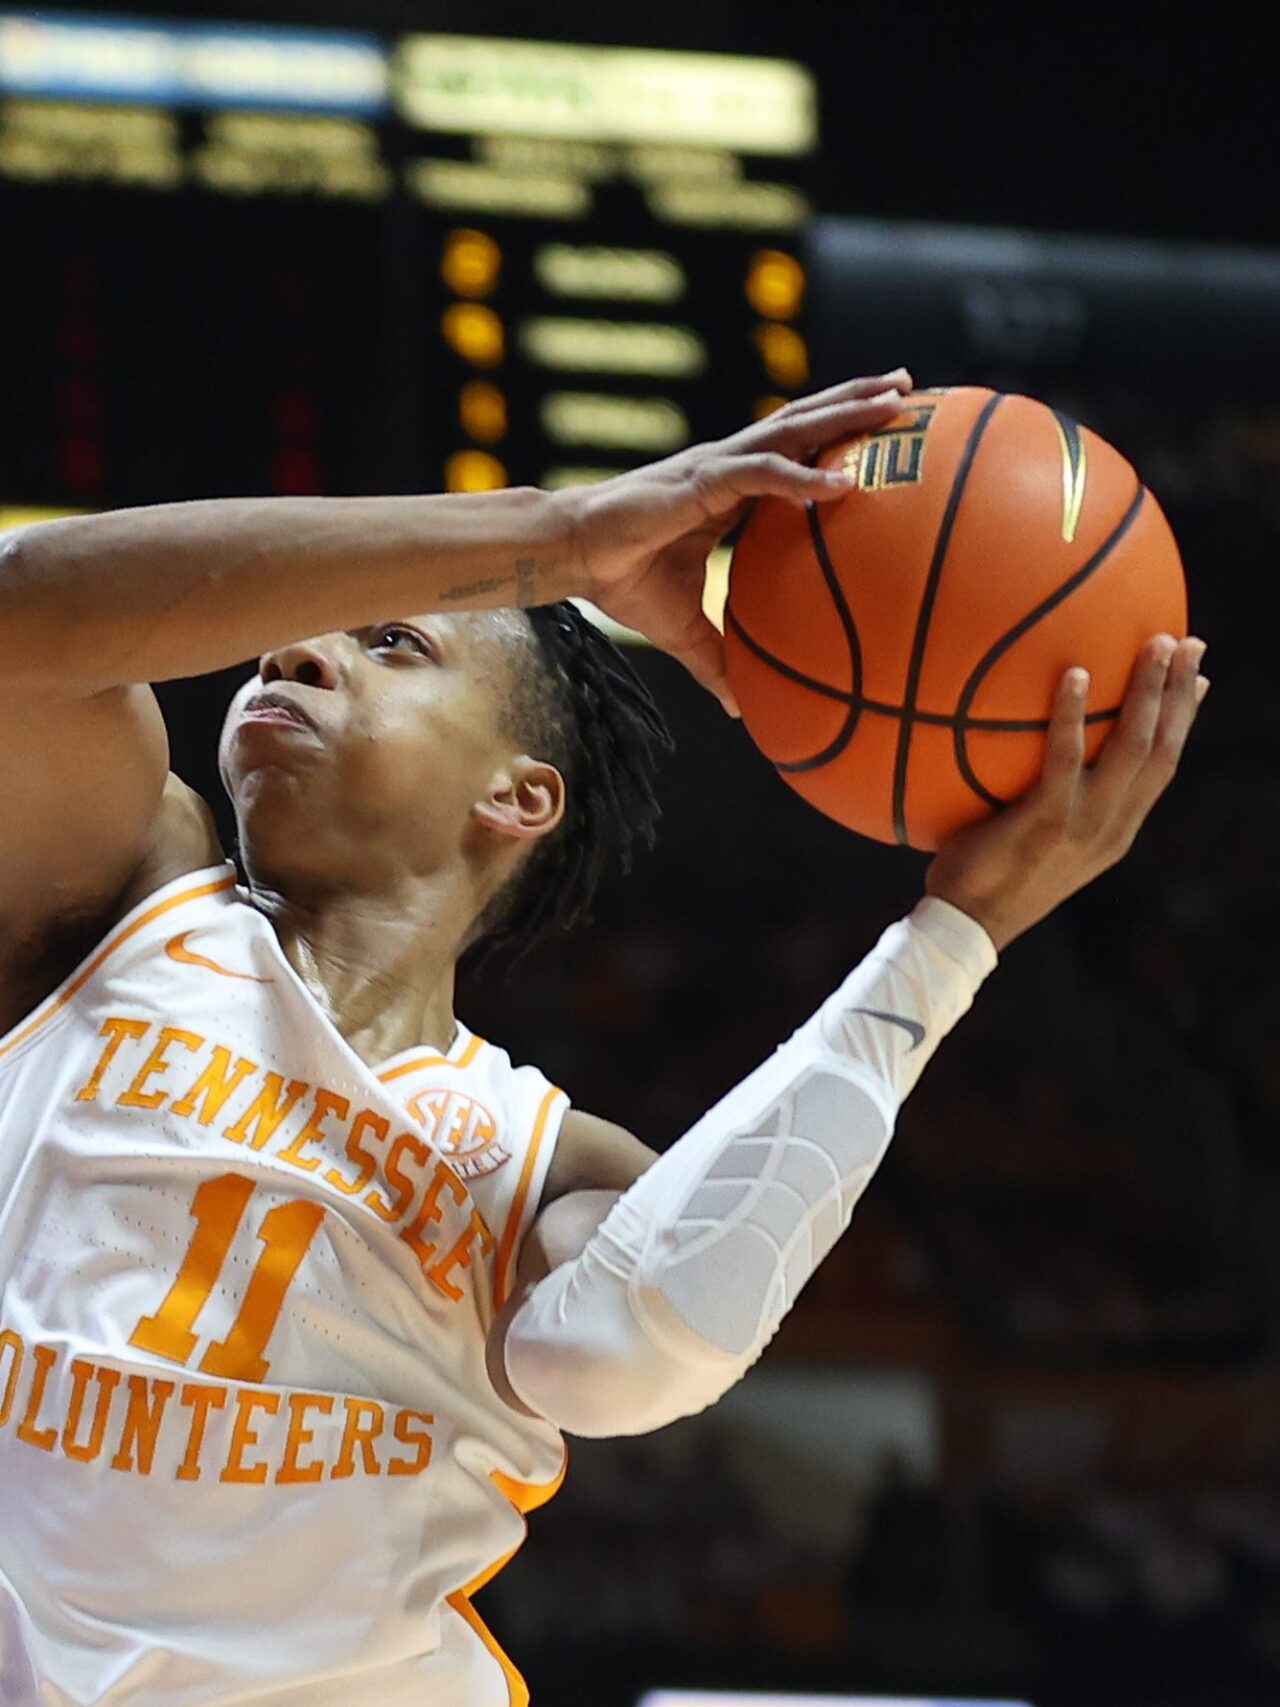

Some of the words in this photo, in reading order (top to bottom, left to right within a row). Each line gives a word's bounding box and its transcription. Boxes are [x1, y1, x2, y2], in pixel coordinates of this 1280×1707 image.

[74, 1017, 495, 1303] TENNESSEE
[407, 1089, 496, 1154] SEC
[129, 1172, 324, 1384] 11
